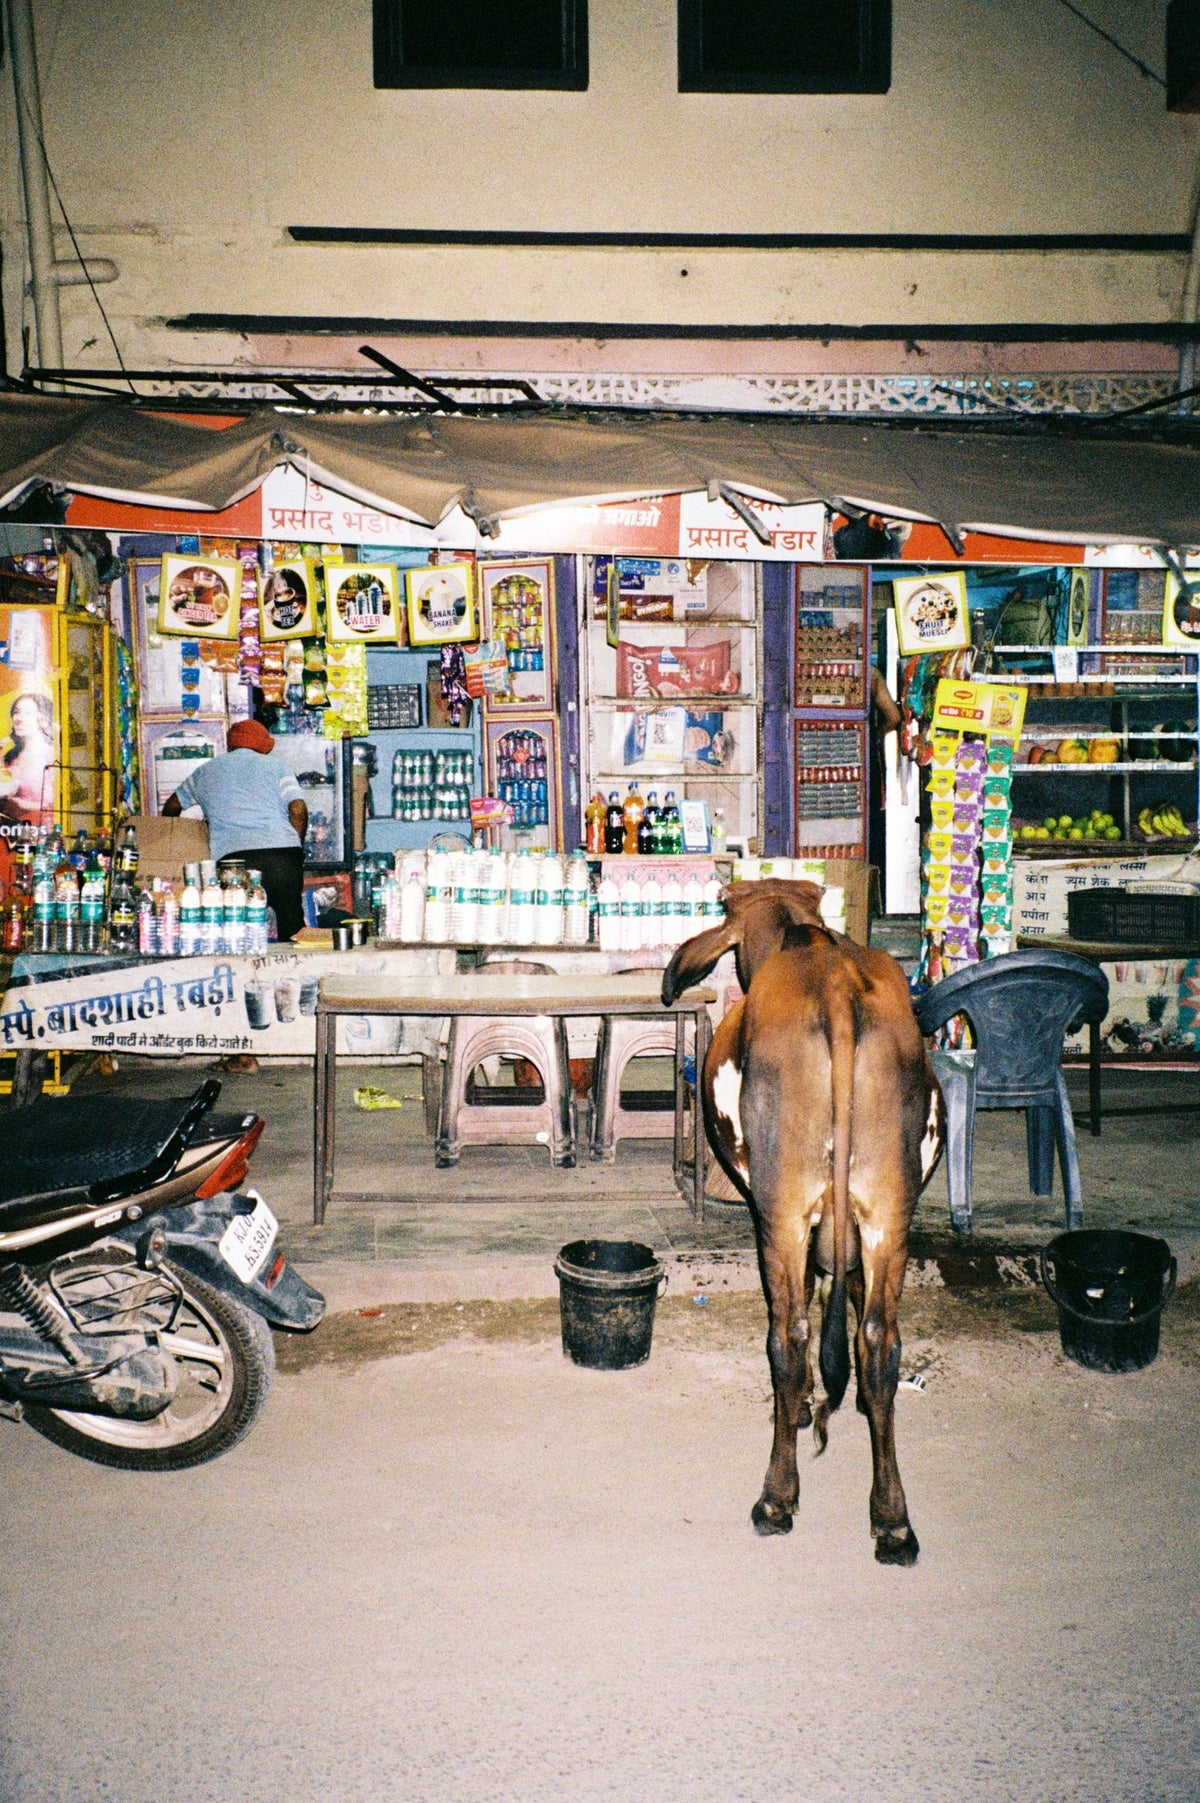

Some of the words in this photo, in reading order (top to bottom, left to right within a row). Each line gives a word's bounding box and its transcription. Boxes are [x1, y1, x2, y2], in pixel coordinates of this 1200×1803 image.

[268, 507, 335, 535] प्रसाद
[685, 527, 749, 553] प्रसाद
[279, 605, 295, 616] HOT
[428, 609, 456, 620] BANANA
[280, 617, 295, 627] TEA
[351, 615, 381, 625] WATER
[433, 619, 456, 628] SHAKE
[919, 619, 945, 630] FRUIT
[918, 629, 949, 638] MUESLI
[1091, 874, 1110, 887] शेक
[1020, 908, 1049, 921] पपीता
[170, 962, 237, 1017] रबड़ी
[91, 1032, 114, 1047] शादी
[116, 1031, 137, 1046] पार्टी
[176, 1036, 195, 1052] बुक
